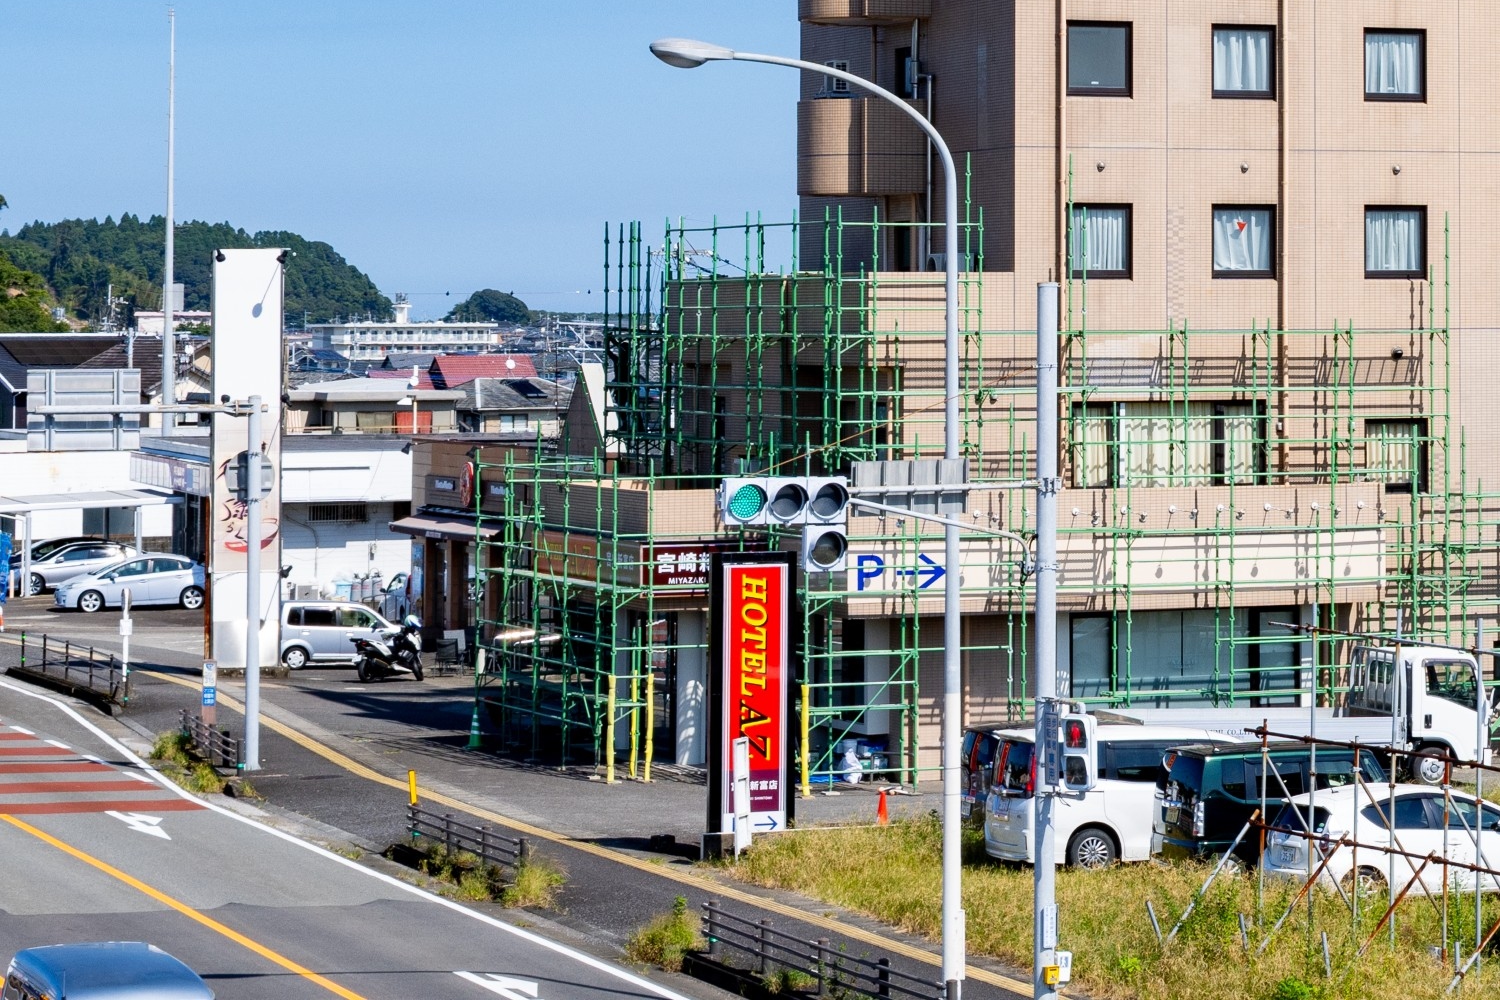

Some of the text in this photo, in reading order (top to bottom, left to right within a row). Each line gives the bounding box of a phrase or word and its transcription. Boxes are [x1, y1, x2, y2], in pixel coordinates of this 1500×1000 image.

[668, 577, 706, 585] MIYAZAKI
[857, 555, 884, 591] P
[740, 573, 771, 761] HOTEL AZ
[730, 780, 778, 791] 新富店
